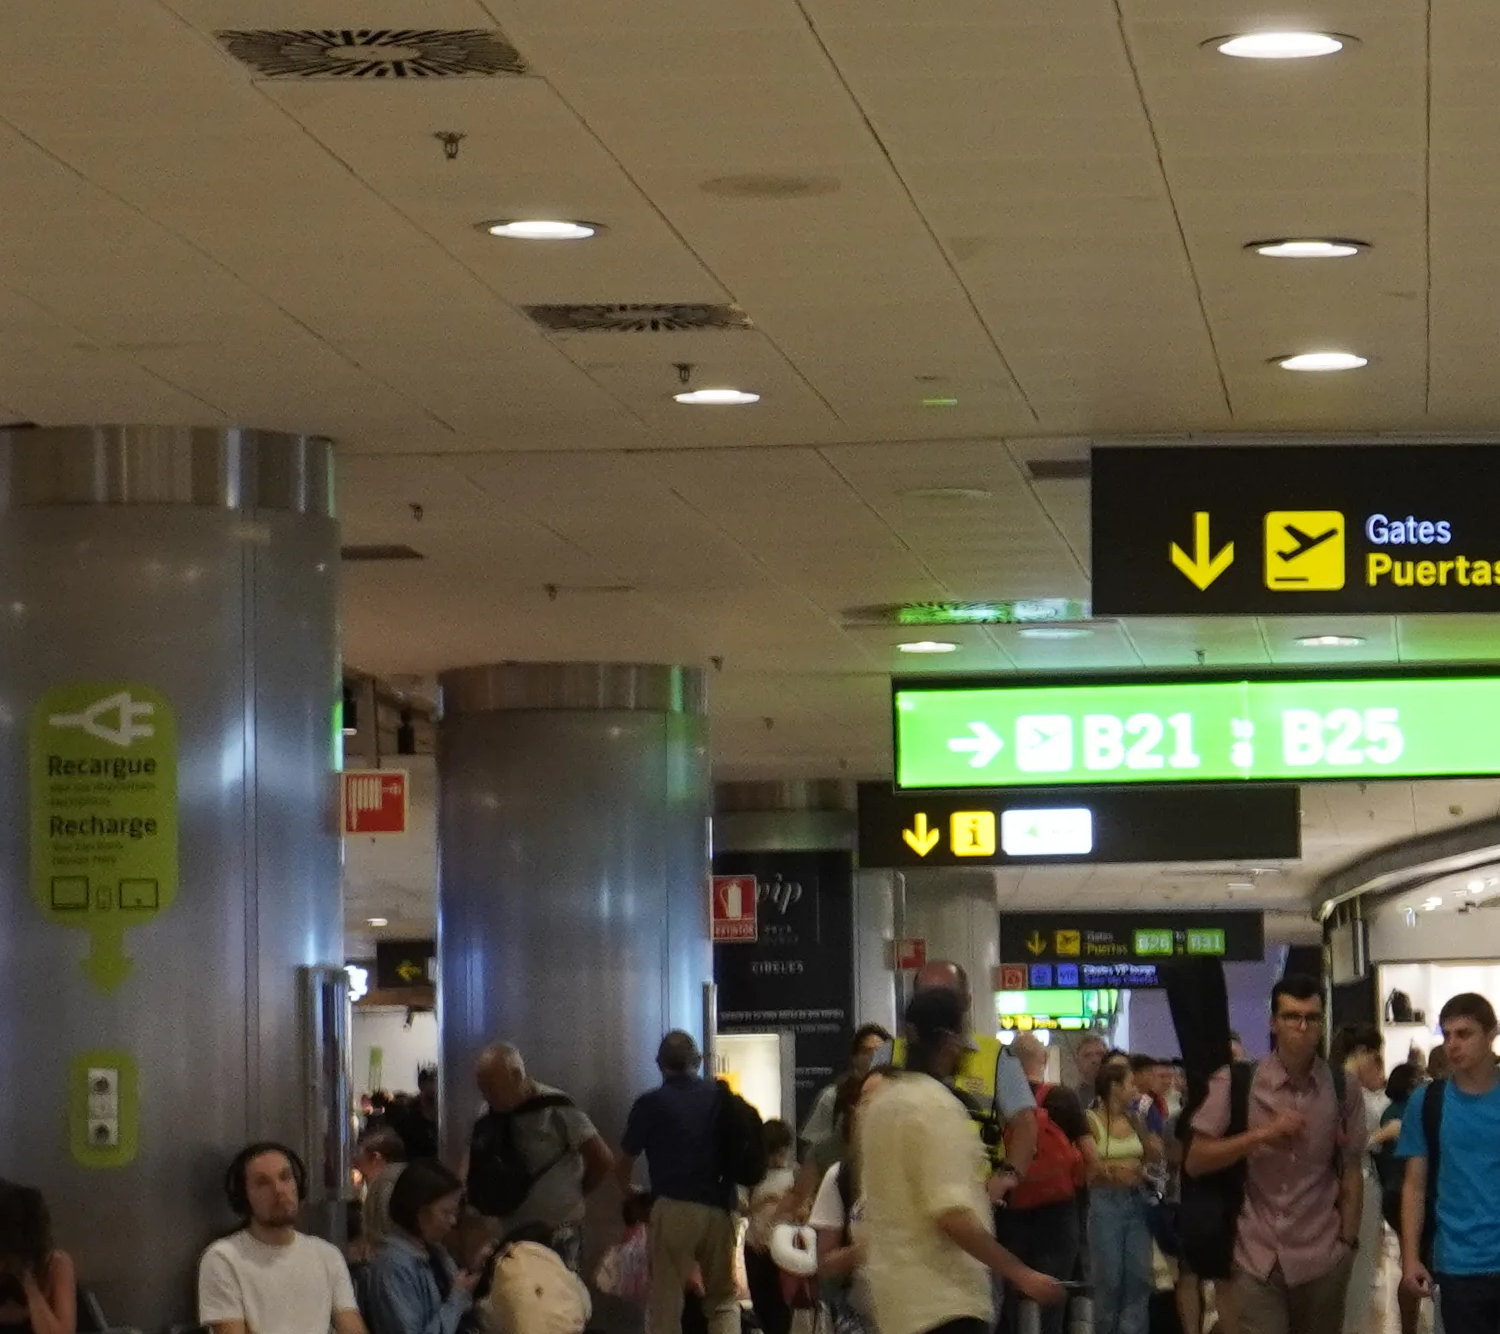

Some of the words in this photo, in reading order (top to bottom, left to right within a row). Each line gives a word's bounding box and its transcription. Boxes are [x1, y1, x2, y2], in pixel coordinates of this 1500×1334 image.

[1366, 513, 1452, 547] Gates
[1082, 713, 1200, 770] B21
[1282, 708, 1404, 766] B25
[48, 755, 158, 780] Recargue
[49, 816, 159, 841] Recharge
